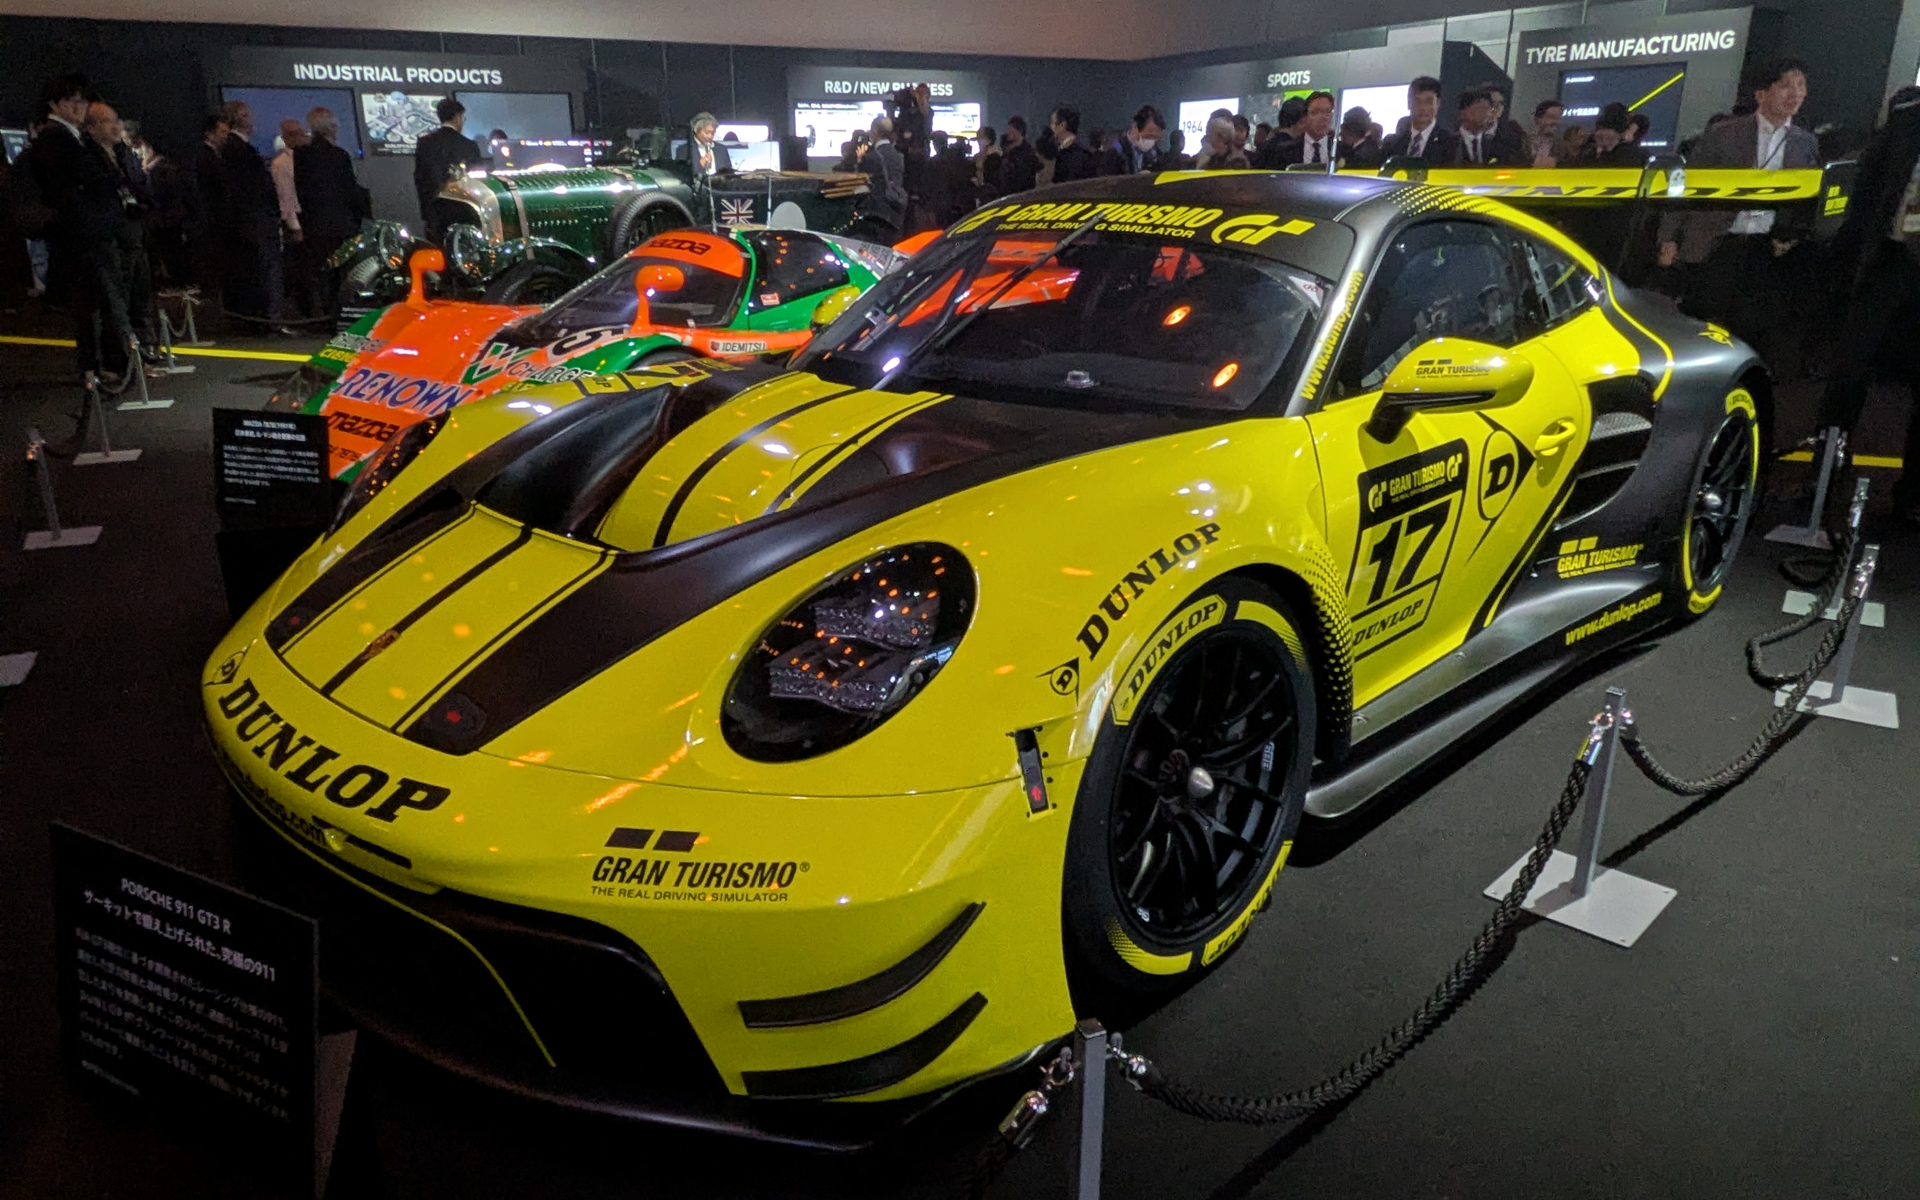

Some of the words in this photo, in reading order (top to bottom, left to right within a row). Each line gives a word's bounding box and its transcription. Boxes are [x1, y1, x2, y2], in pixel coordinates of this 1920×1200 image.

[1526, 45, 1567, 64] TYRE
[1569, 30, 1736, 61] MANUFACTURING
[294, 64, 403, 82] INDUSTRIAL
[406, 67, 503, 85] PRODUCTS
[824, 80, 852, 94] R&D
[860, 81, 890, 95] NEW
[1267, 70, 1311, 88] SPORTS
[1182, 120, 1203, 133] 1964
[1006, 203, 1092, 221] GRAN
[1095, 203, 1224, 228] TURISMO
[1018, 222, 1048, 230] REAL
[1051, 222, 1105, 231] DRIVG
[1108, 223, 1196, 239] SIMULATOR
[721, 342, 766, 352] IDEMITSU
[1416, 366, 1445, 376] GRAN
[333, 368, 475, 416] RENOWN
[328, 411, 400, 441] mazda
[1389, 473, 1412, 496] GRAN
[1412, 460, 1446, 487] TURISMO
[1367, 498, 1452, 606] 17
[1557, 553, 1588, 573] GRAN
[1076, 522, 1221, 662] DUNLOP
[1353, 598, 1424, 647] DUNLOP
[1565, 592, 1663, 646] www.dunlop.com
[1128, 601, 1218, 701] DUNLOP
[218, 677, 452, 823] DUNLOP
[592, 855, 670, 886] GRAN
[120, 877, 173, 911] PORSCHE
[174, 899, 195, 920] 911
[197, 908, 220, 931] GT3
[222, 918, 232, 935] R
[591, 885, 616, 897] THE
[618, 888, 651, 900] REAL
[653, 890, 706, 901] DRIVING
[711, 891, 788, 903] SIMULATOR
